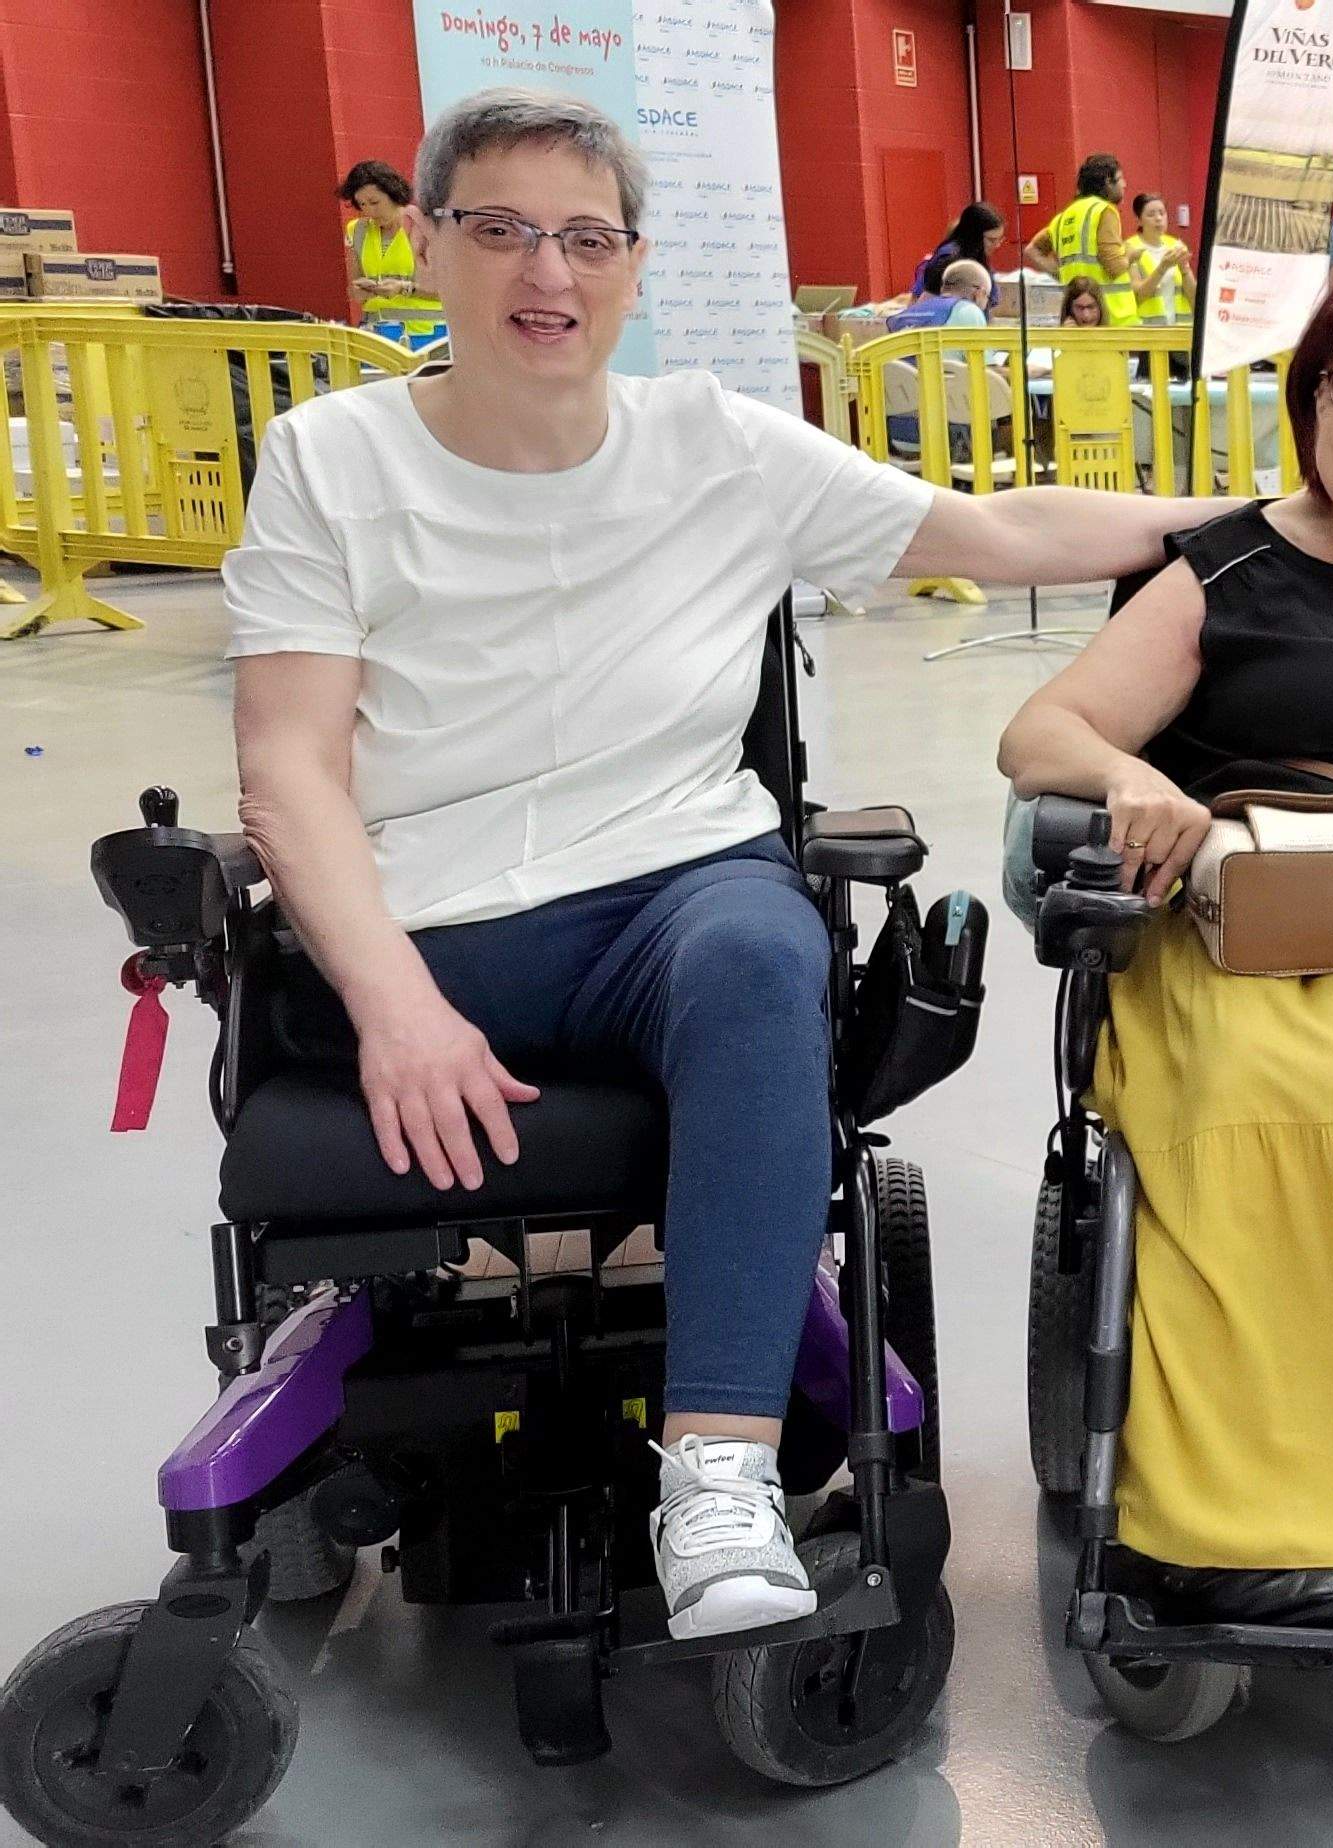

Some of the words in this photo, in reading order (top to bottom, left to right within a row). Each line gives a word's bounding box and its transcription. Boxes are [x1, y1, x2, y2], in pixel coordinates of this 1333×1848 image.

[532, 24, 543, 51] 7
[550, 14, 571, 46] de
[579, 29, 622, 61] mayo
[1272, 27, 1330, 47] VIÑAS
[1253, 48, 1288, 64] DEL
[500, 58, 534, 71] Palacio
[534, 61, 546, 72] de
[548, 63, 595, 76] Congresos
[704, 1453, 735, 1465] ewfeel
